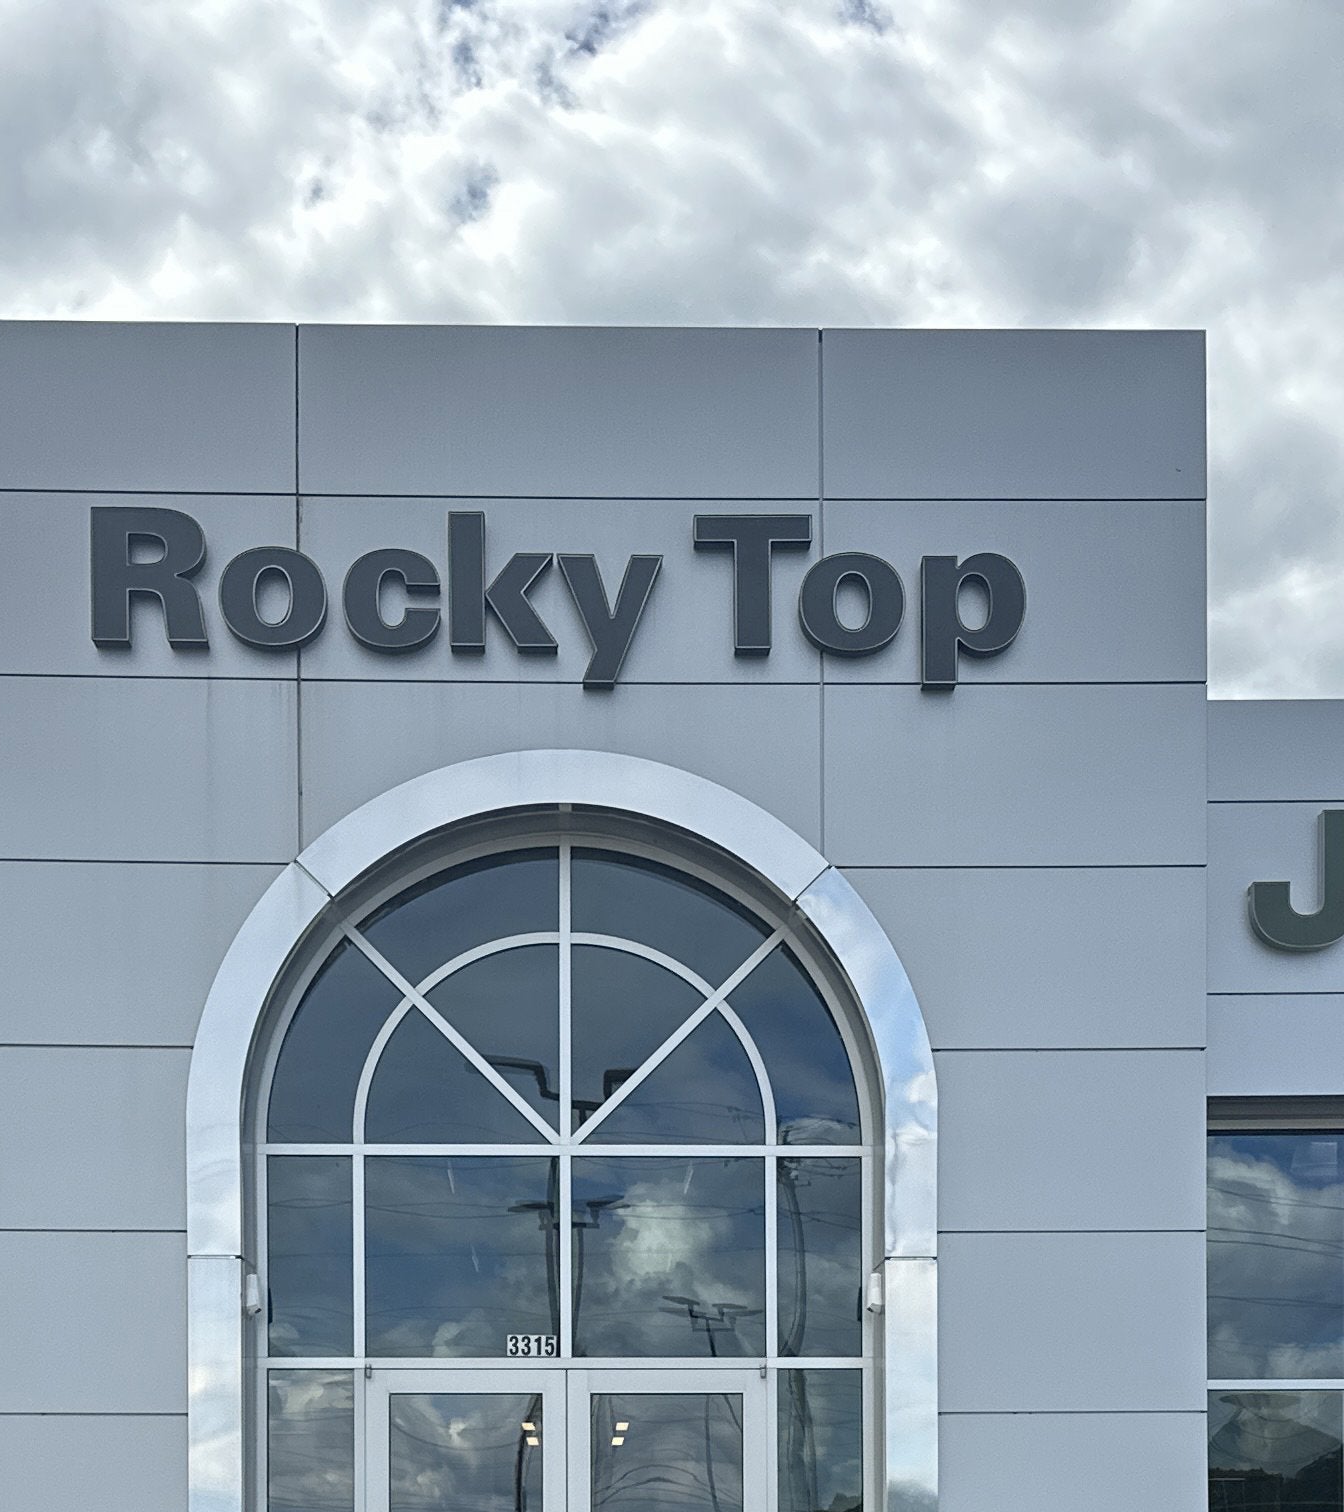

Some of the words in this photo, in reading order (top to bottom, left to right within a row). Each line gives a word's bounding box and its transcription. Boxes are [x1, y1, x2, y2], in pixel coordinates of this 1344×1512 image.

[91, 506, 663, 690] Rocky
[693, 514, 1027, 691] Top
[509, 1335, 555, 1356] 3315
